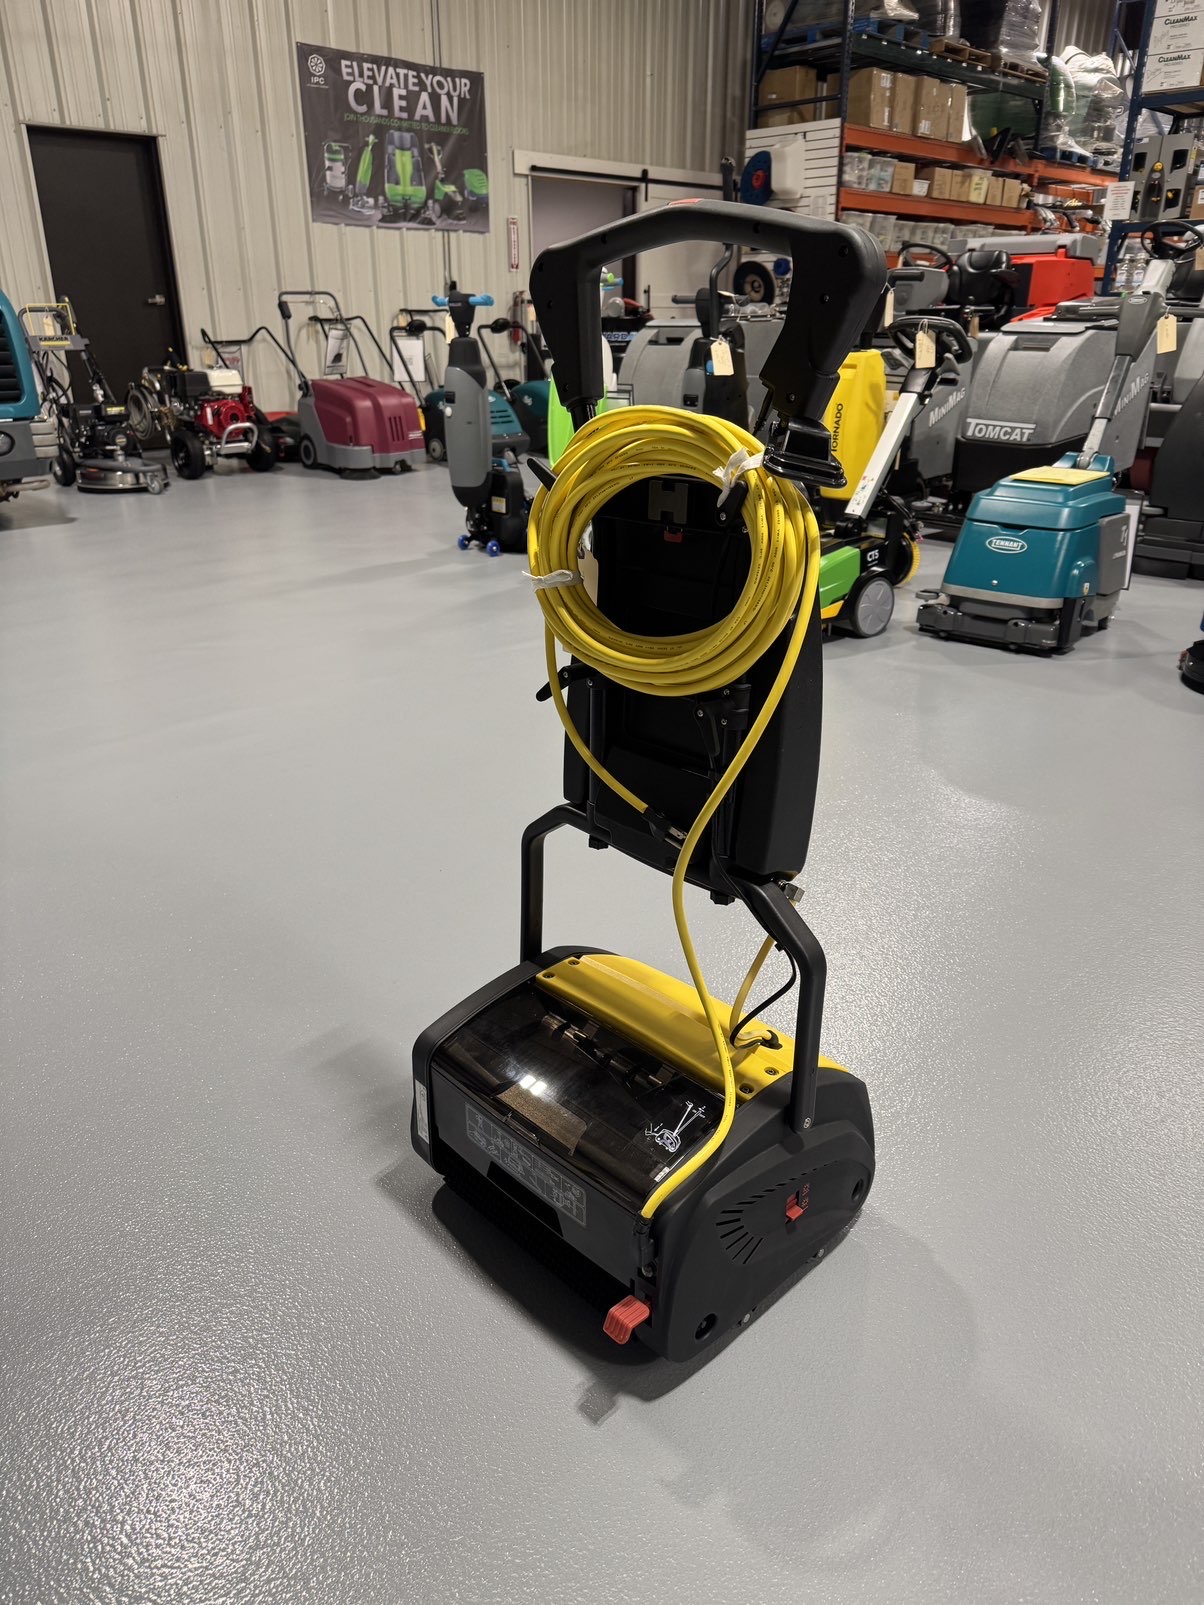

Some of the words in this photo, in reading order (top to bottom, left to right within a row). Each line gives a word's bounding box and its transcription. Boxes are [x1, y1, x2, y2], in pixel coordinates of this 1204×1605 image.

[311, 76, 325, 84] IPC
[340, 59, 420, 91] ELEVATE
[420, 72, 471, 99] YOUR
[347, 82, 458, 125] CLEAN
[966, 418, 1036, 442] TOMCAT
[991, 539, 1023, 551] TENNANT
